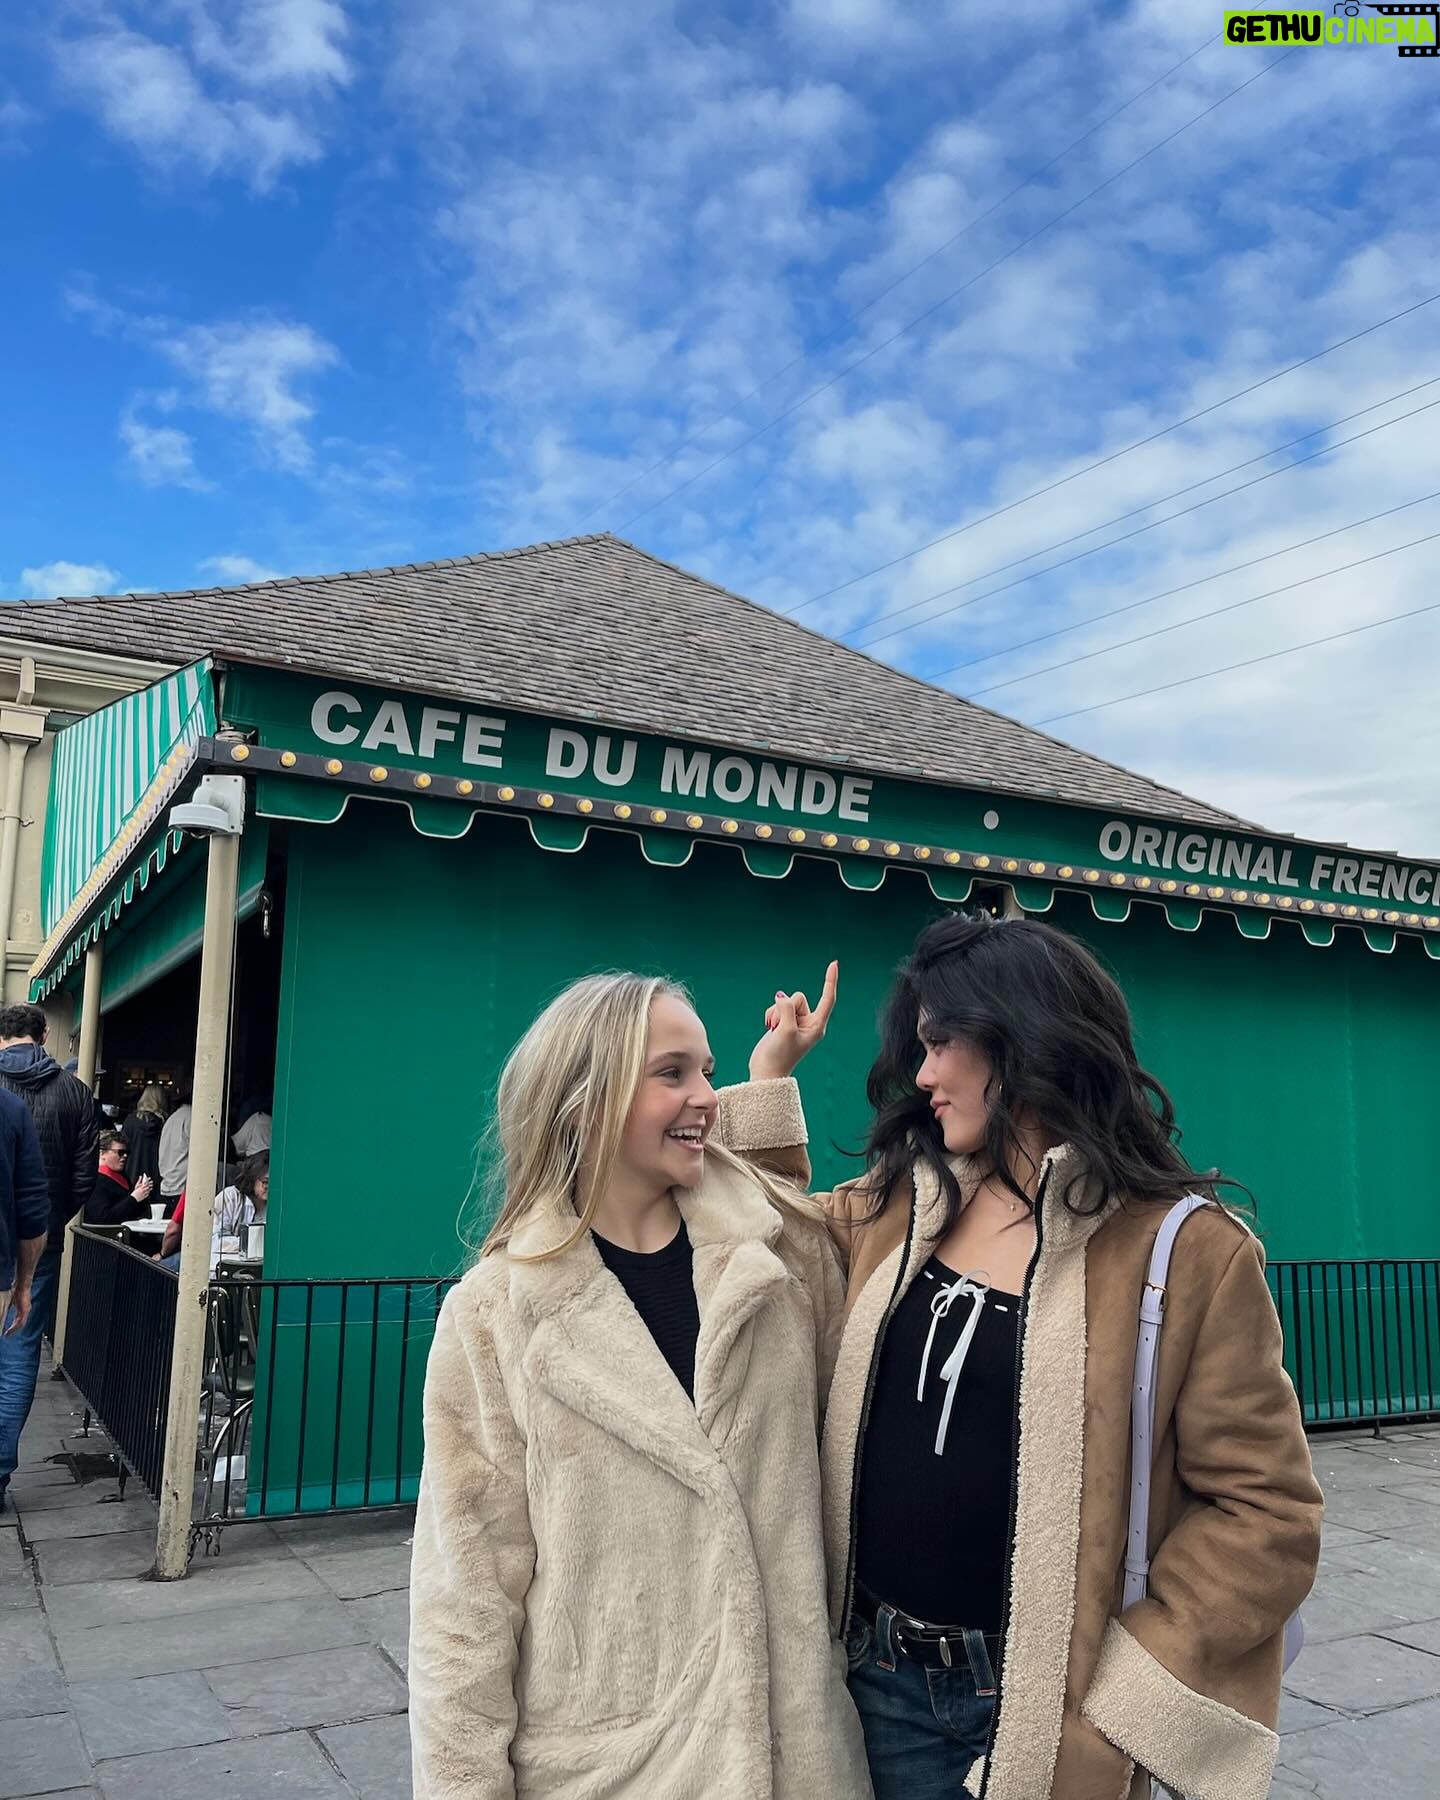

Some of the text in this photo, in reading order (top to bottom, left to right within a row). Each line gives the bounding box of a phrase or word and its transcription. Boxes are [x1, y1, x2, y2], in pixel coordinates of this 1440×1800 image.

[310, 691, 506, 768] CAFE
[545, 728, 638, 786] DU
[660, 746, 873, 822] MONDE
[1099, 821, 1299, 888] ORIGINAL
